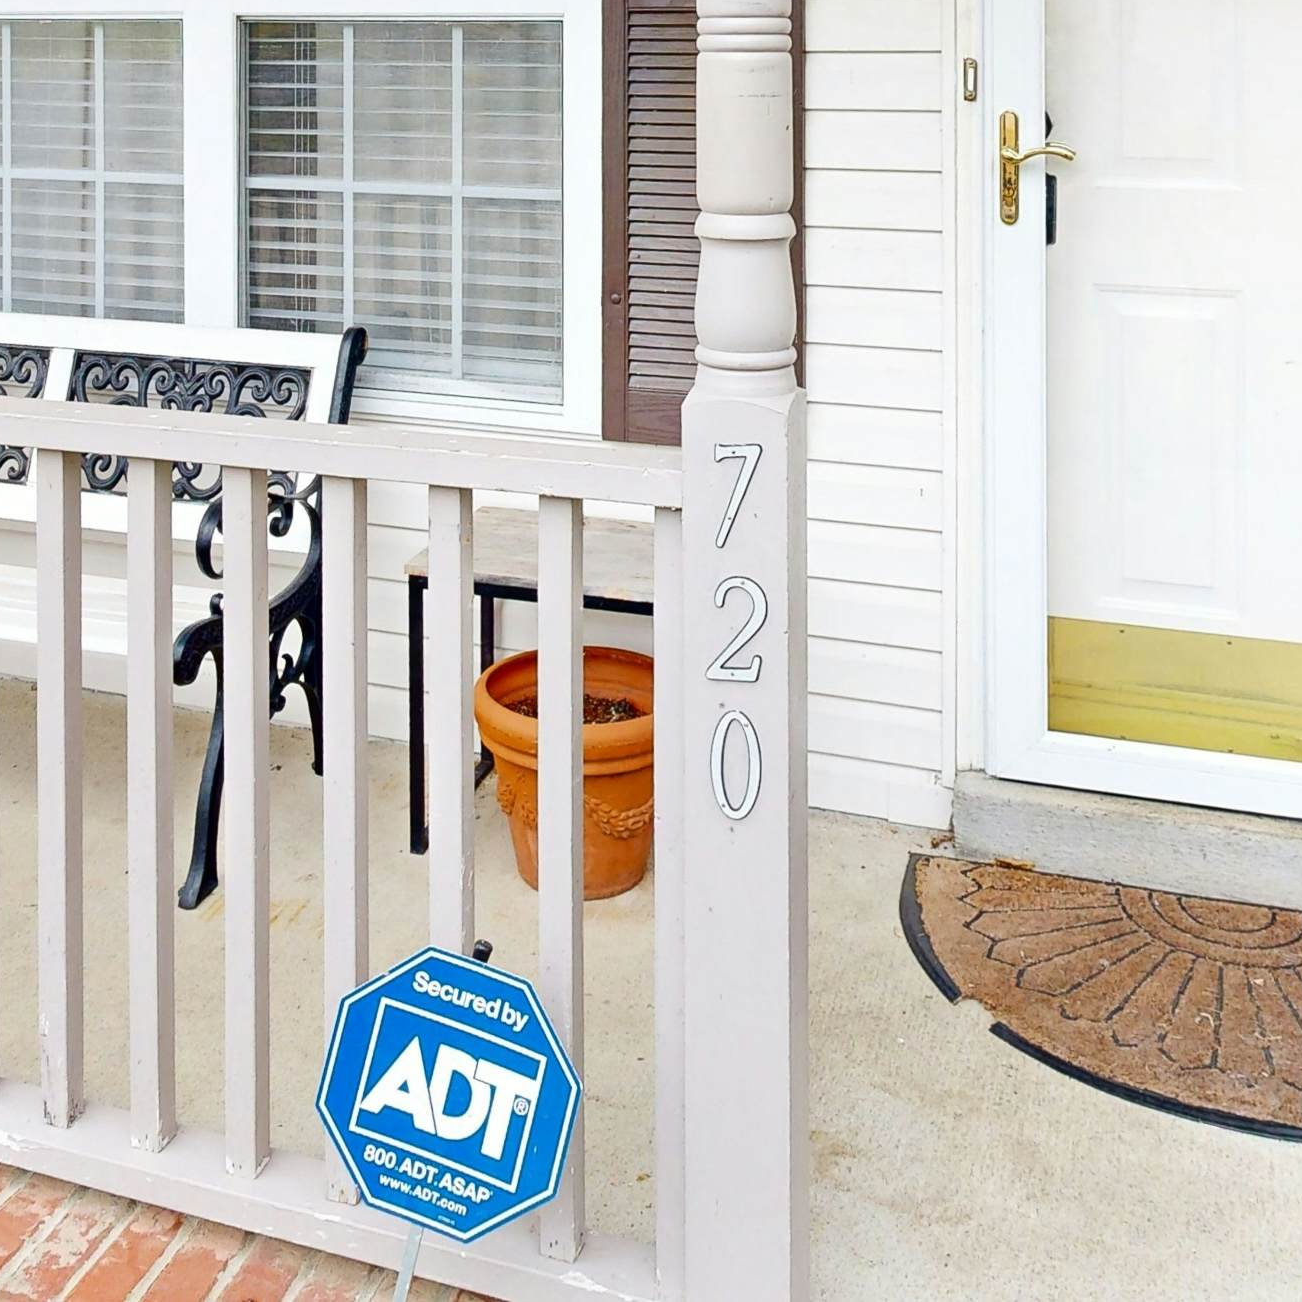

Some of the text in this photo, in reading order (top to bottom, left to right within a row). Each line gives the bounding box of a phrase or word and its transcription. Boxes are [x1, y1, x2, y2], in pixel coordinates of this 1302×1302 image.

[705, 442, 768, 821] 720
[412, 970, 529, 1032] Secured by
[358, 1035, 536, 1161] ADT
[379, 1174, 468, 1216] www.ADT.com
